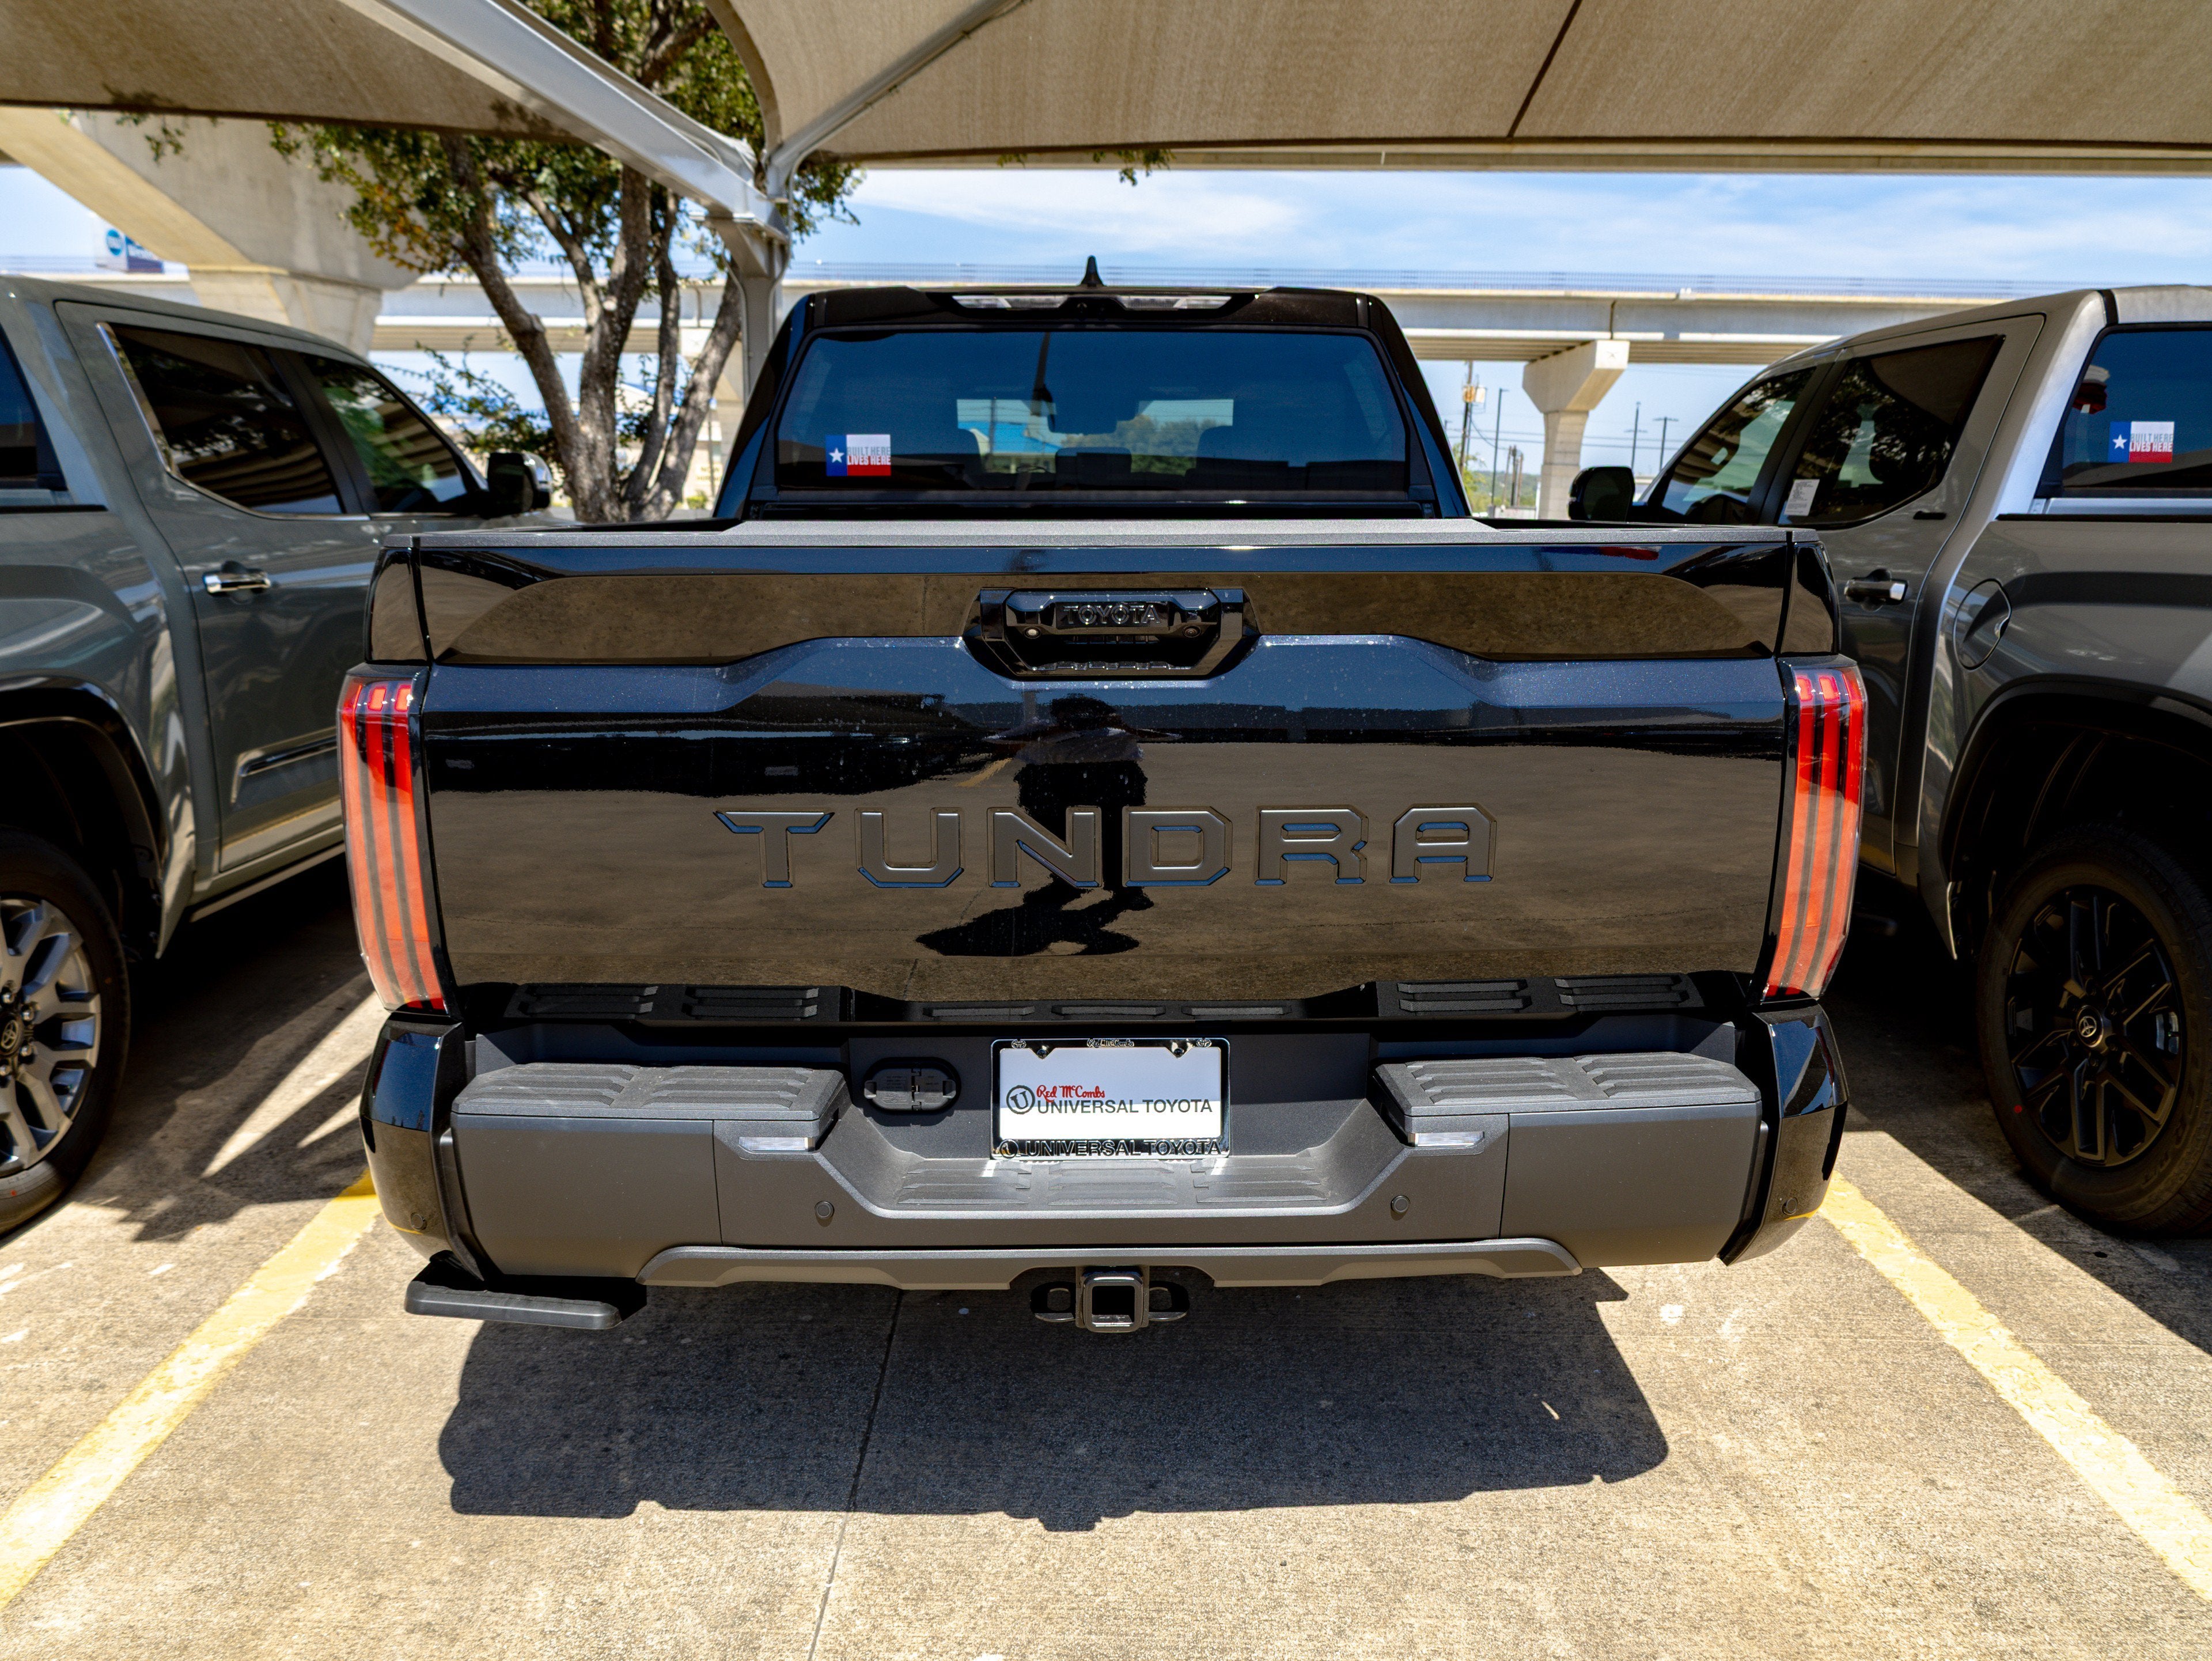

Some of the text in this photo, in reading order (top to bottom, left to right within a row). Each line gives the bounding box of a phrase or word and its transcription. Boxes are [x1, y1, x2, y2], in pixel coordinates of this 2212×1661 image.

[2153, 433, 2173, 442] HERE
[870, 446, 891, 456] HERE
[2130, 442, 2173, 452] LIVES HERE
[847, 455, 891, 466] LIVES HERE
[1063, 604, 1161, 625] TOYOTA
[713, 805, 1499, 889] TUNDRA
[1036, 1084, 1105, 1103] Red McCombs
[1037, 1099, 1213, 1114] UNIVERSAL TOYOTA
[1027, 1138, 1222, 1157] UNIVERSAL TOYOTA
